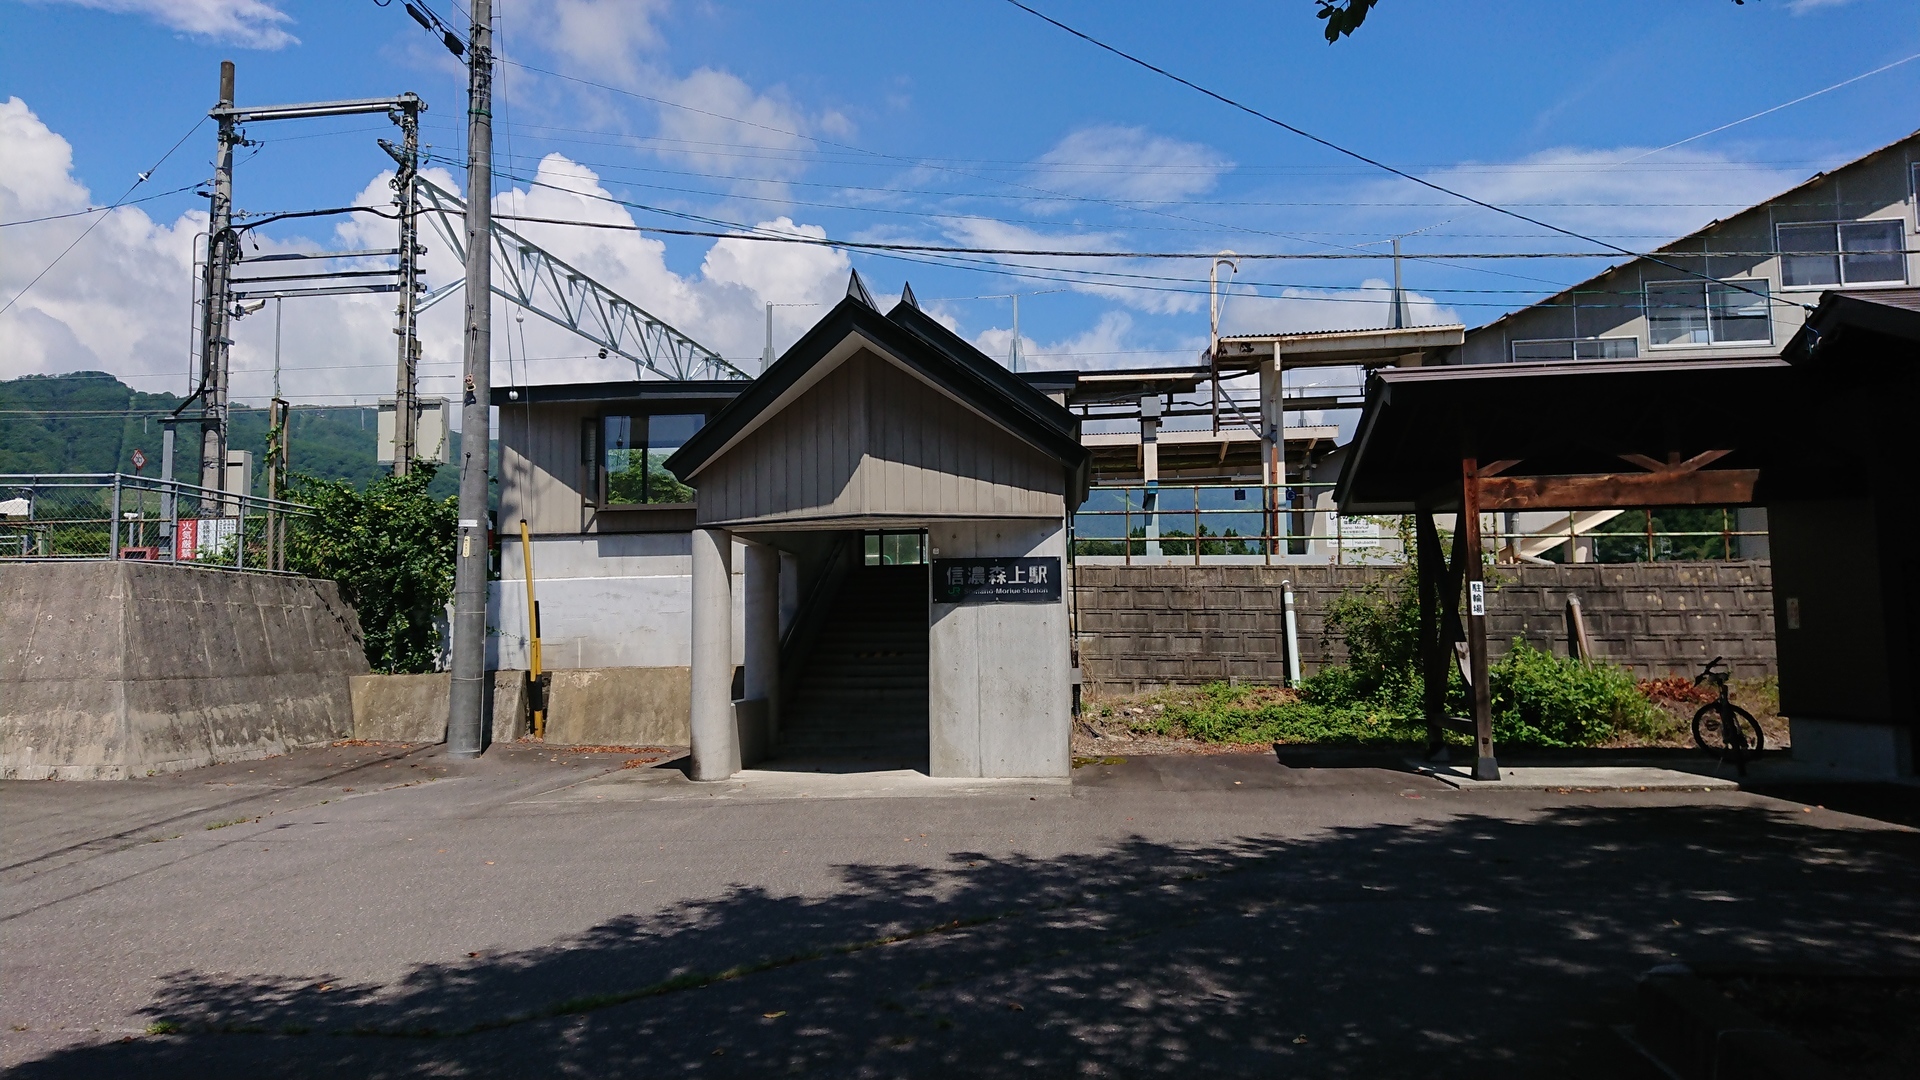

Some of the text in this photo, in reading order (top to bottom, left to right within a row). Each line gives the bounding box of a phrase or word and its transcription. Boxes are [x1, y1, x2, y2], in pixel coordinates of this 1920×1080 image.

[946, 565, 1048, 586] 信濃森上駅
[948, 587, 960, 596] JR
[1022, 586, 1049, 594] Station
[1472, 584, 1482, 613] 駐輪場
